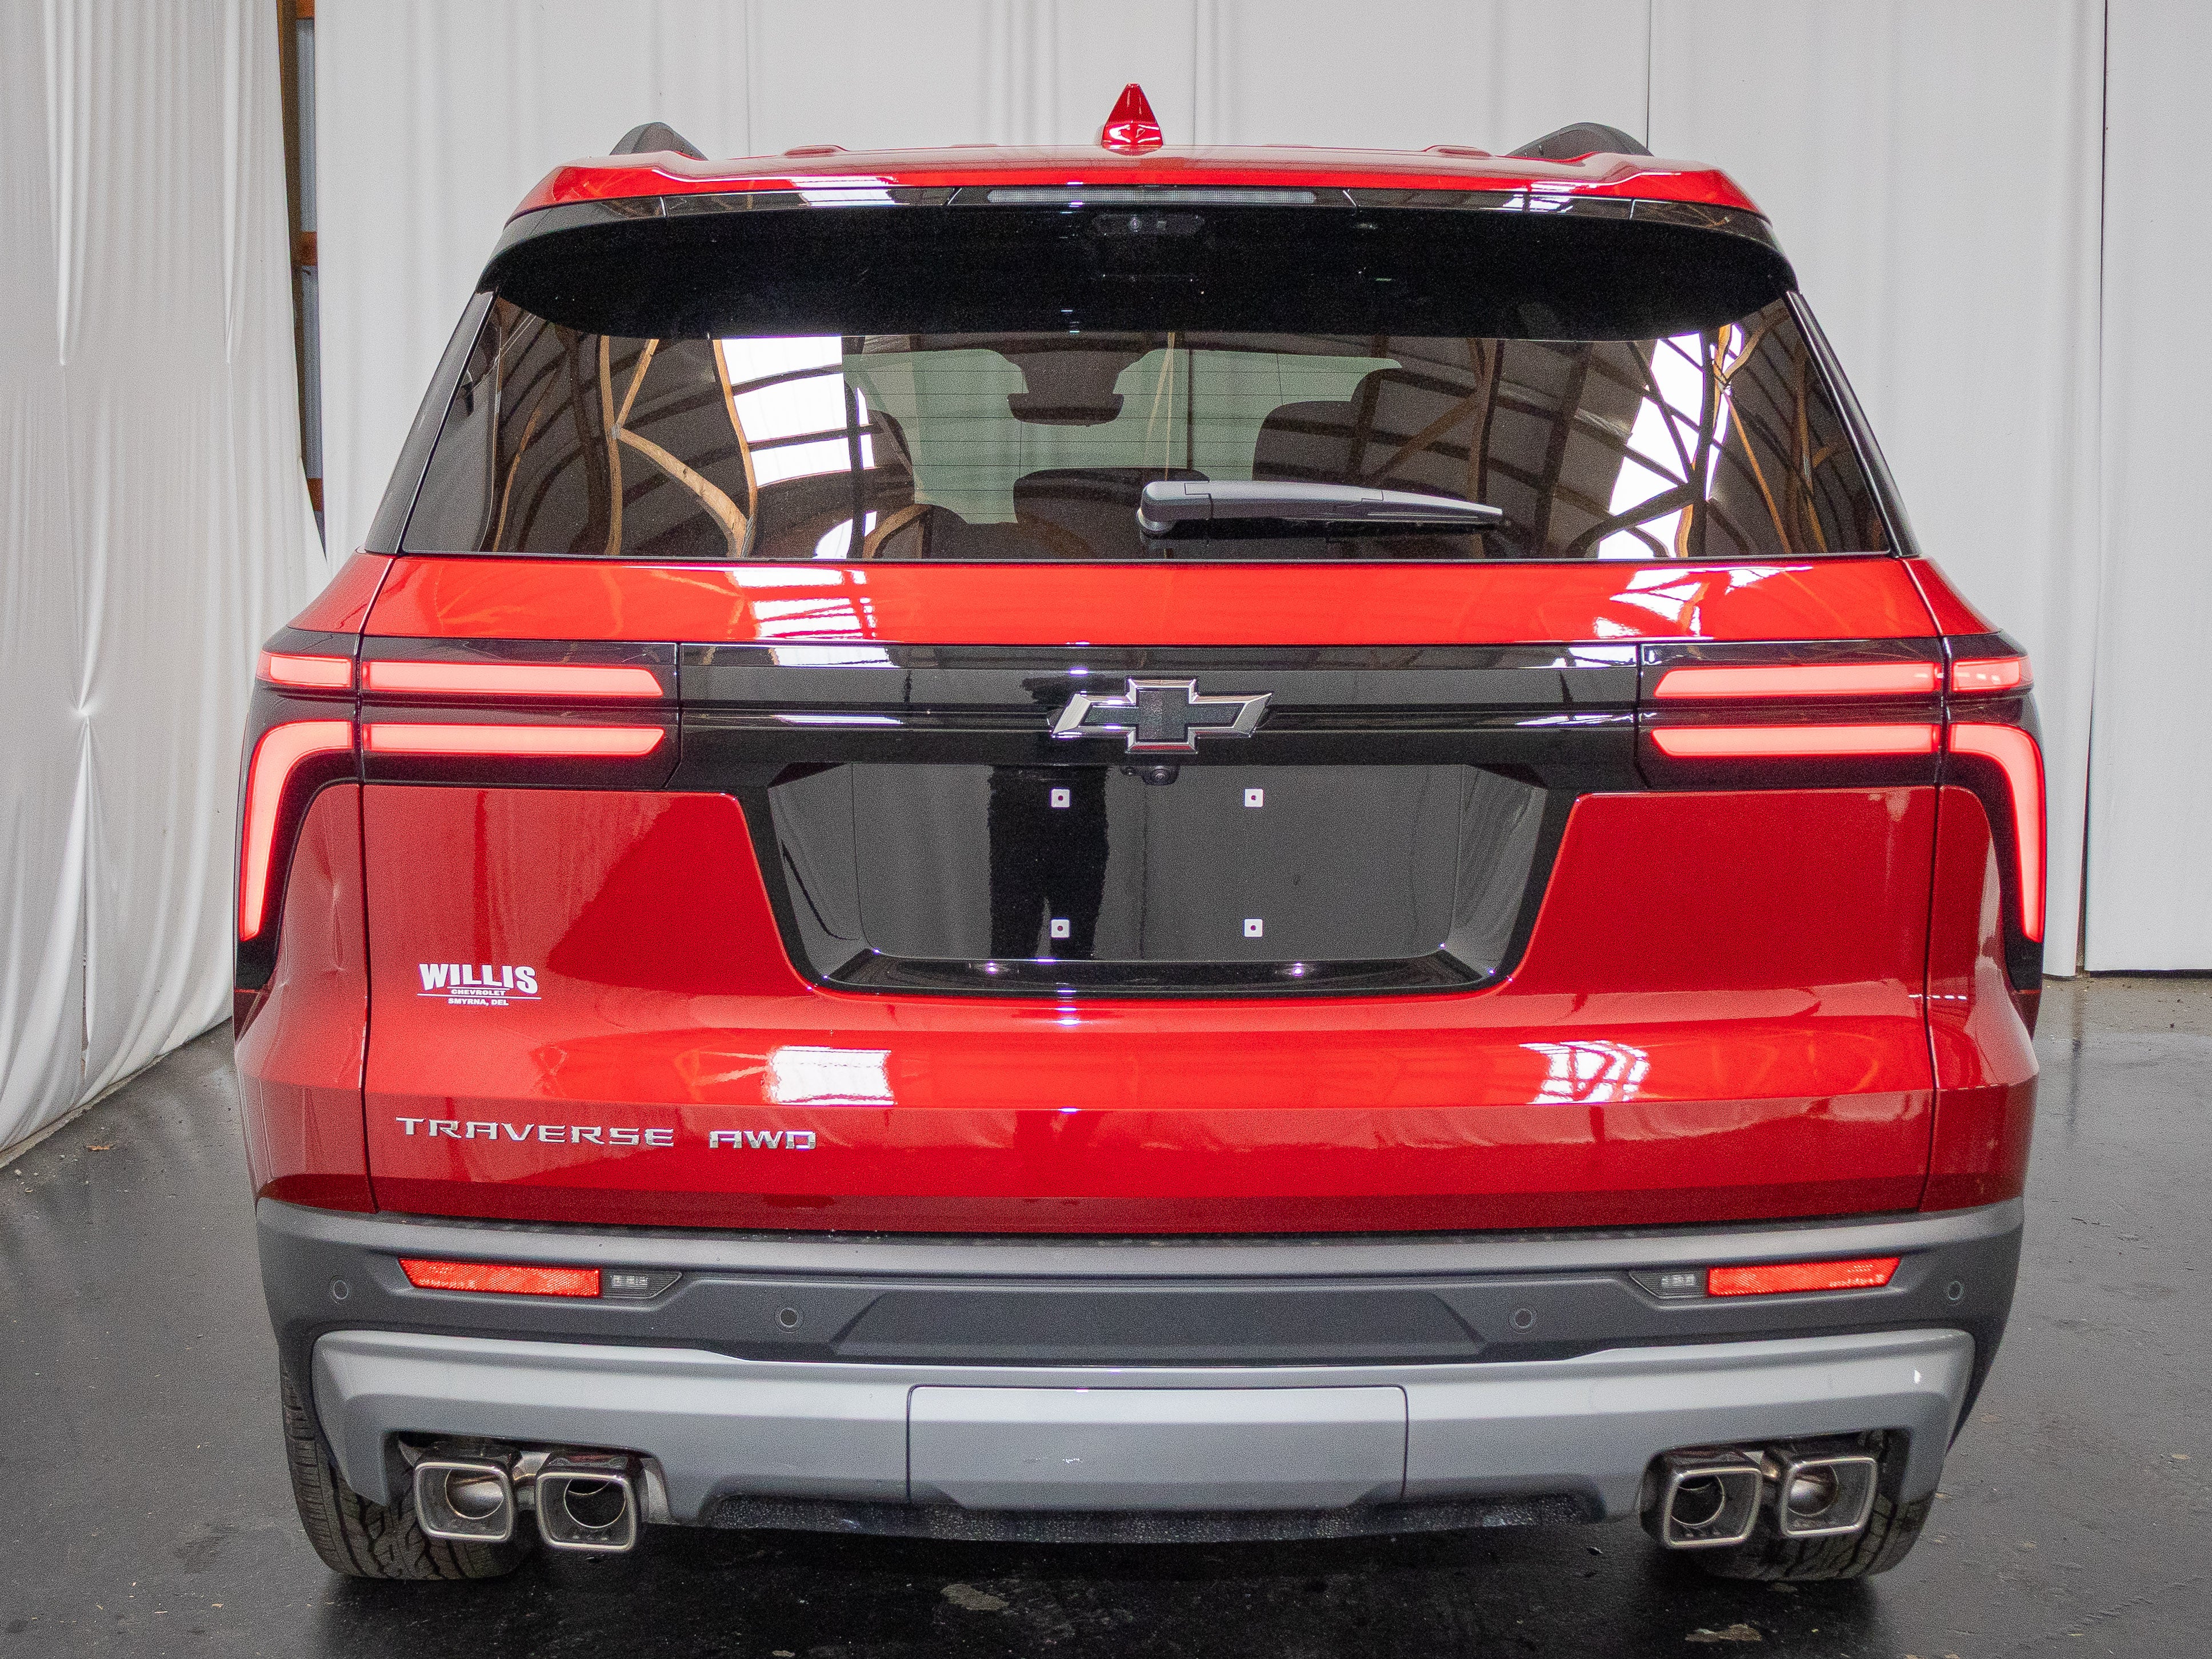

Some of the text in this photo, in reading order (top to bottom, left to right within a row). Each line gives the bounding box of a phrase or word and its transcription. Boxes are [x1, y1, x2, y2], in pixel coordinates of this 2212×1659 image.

[418, 963, 539, 994] WILLIS
[447, 998, 489, 1006] SMYRNA,
[395, 1116, 817, 1150] TRAVERSE AWD
